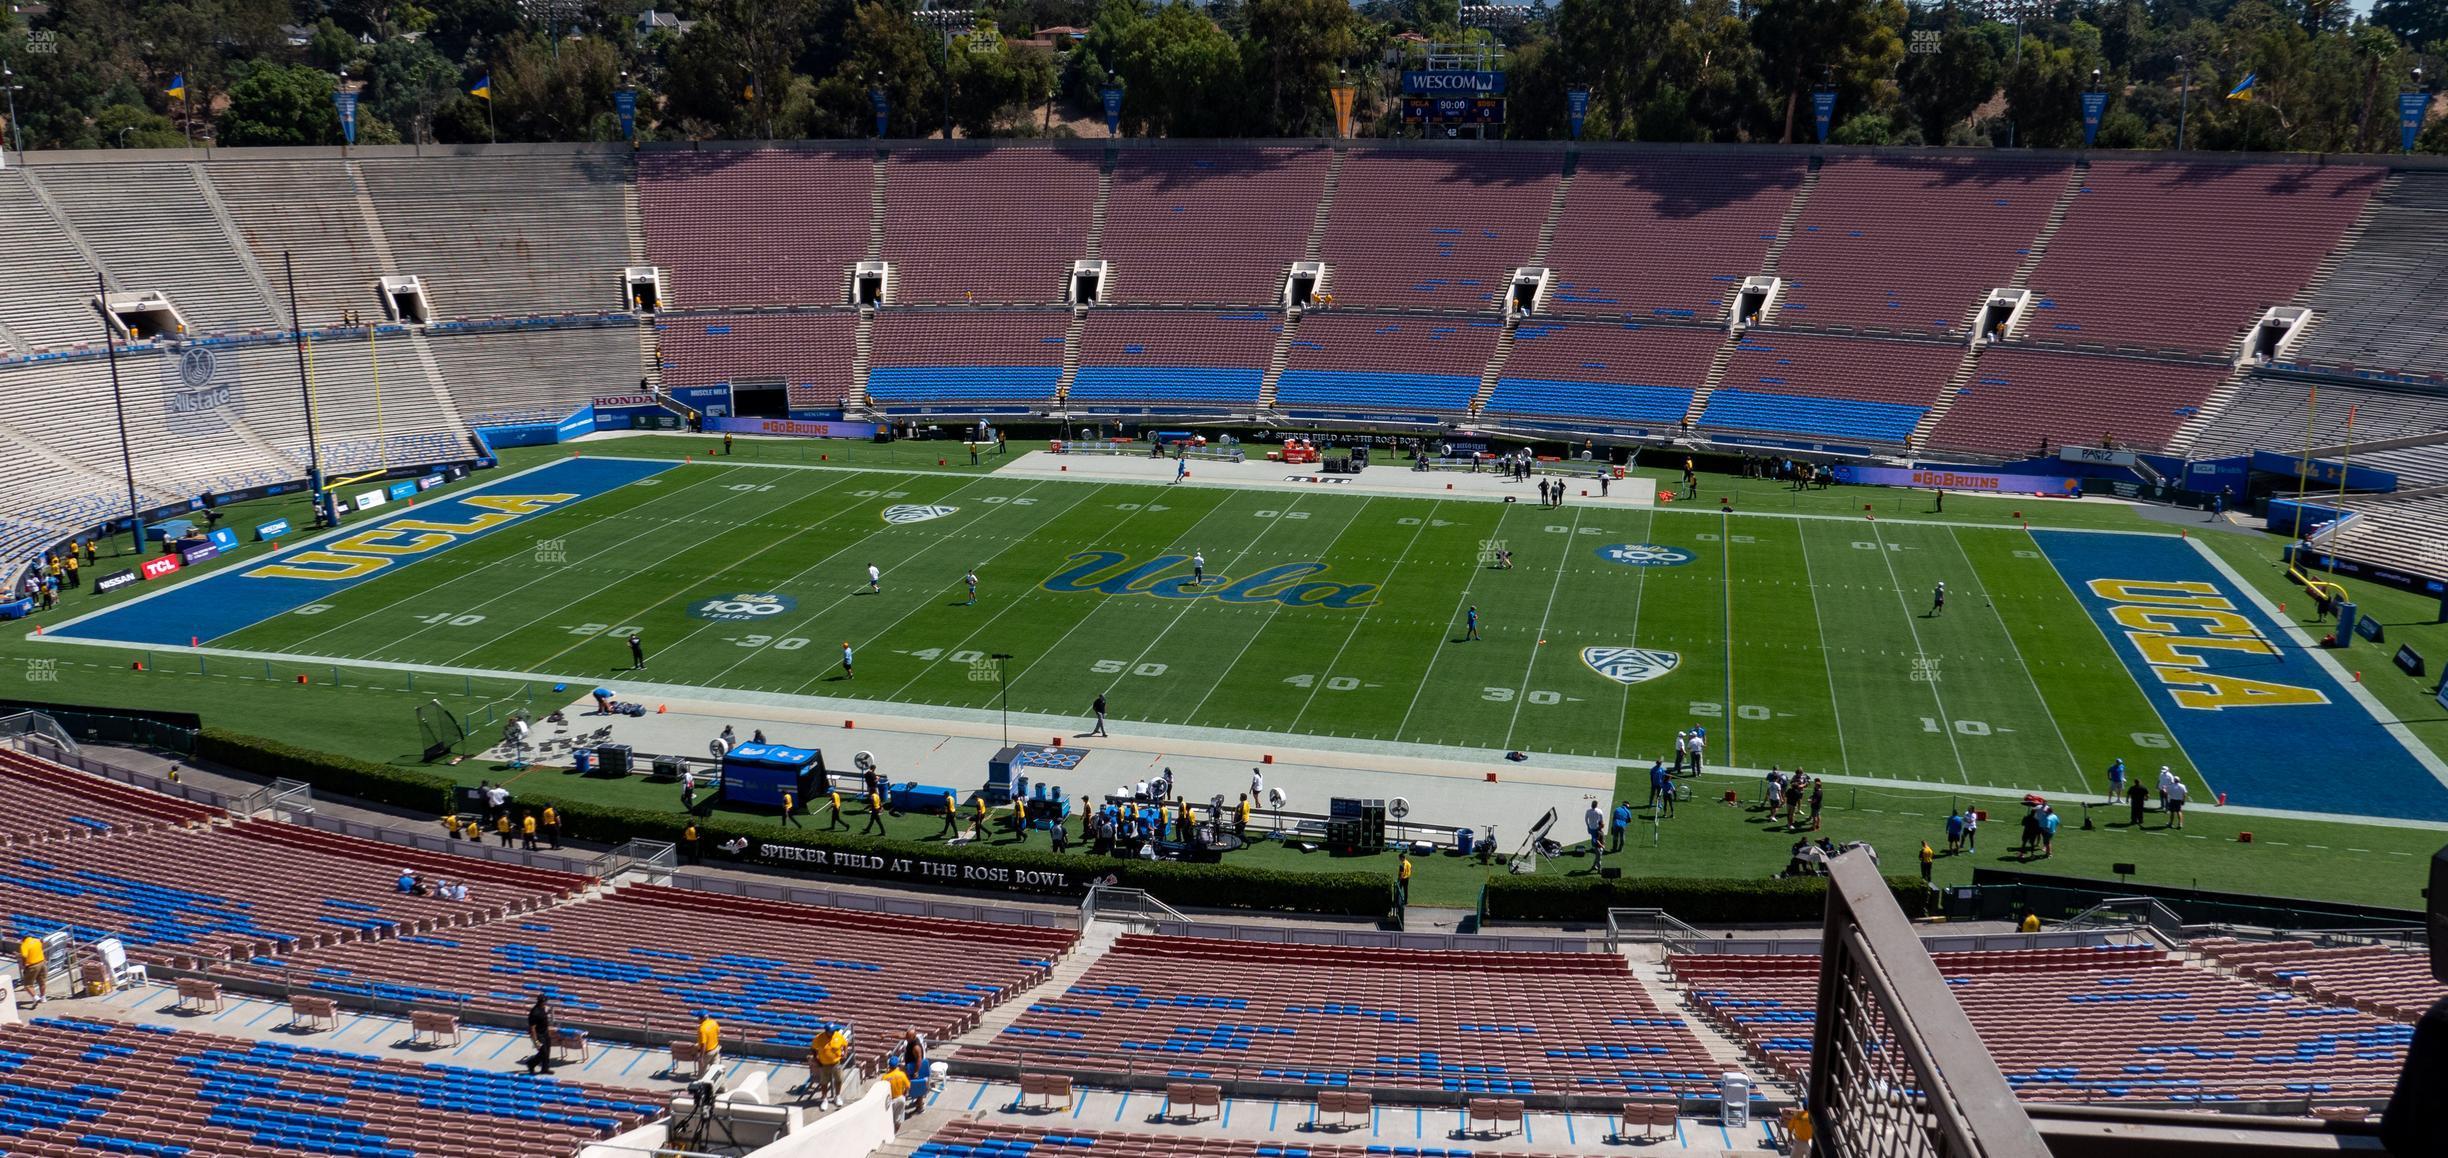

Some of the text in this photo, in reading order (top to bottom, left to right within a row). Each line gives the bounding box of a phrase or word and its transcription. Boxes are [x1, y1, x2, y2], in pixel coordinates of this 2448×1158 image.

[1413, 75, 1475, 89] WESCOM
[1440, 101, 1465, 109] 90:00
[1448, 128, 1457, 136] 42
[173, 388, 230, 412] Allstate
[594, 396, 655, 406] HONDA
[1312, 433, 1338, 442] FIELD
[1253, 510, 1312, 520] 50
[240, 493, 581, 581] UCLA
[1608, 550, 1688, 562] 100
[1621, 558, 1670, 566] YEARS
[147, 558, 176, 575] TCL
[100, 572, 136, 590] NISSAN
[1038, 550, 1384, 610] Ucla
[700, 600, 785, 615] 100
[702, 612, 752, 620] YEARS
[568, 623, 644, 638] 20
[735, 634, 811, 650] 30
[2086, 578, 2332, 712] UCLA
[911, 648, 984, 663] 40
[1090, 659, 1168, 677] 50
[1611, 665, 1649, 678] 12
[1282, 674, 1361, 691] 40
[1480, 686, 1561, 705] 30
[1688, 700, 1770, 721] 20
[1918, 717, 1992, 736] 10
[2130, 732, 2172, 749] G
[760, 844, 1069, 887] SPIEKER FIELD AT THE ROSE BOWL
